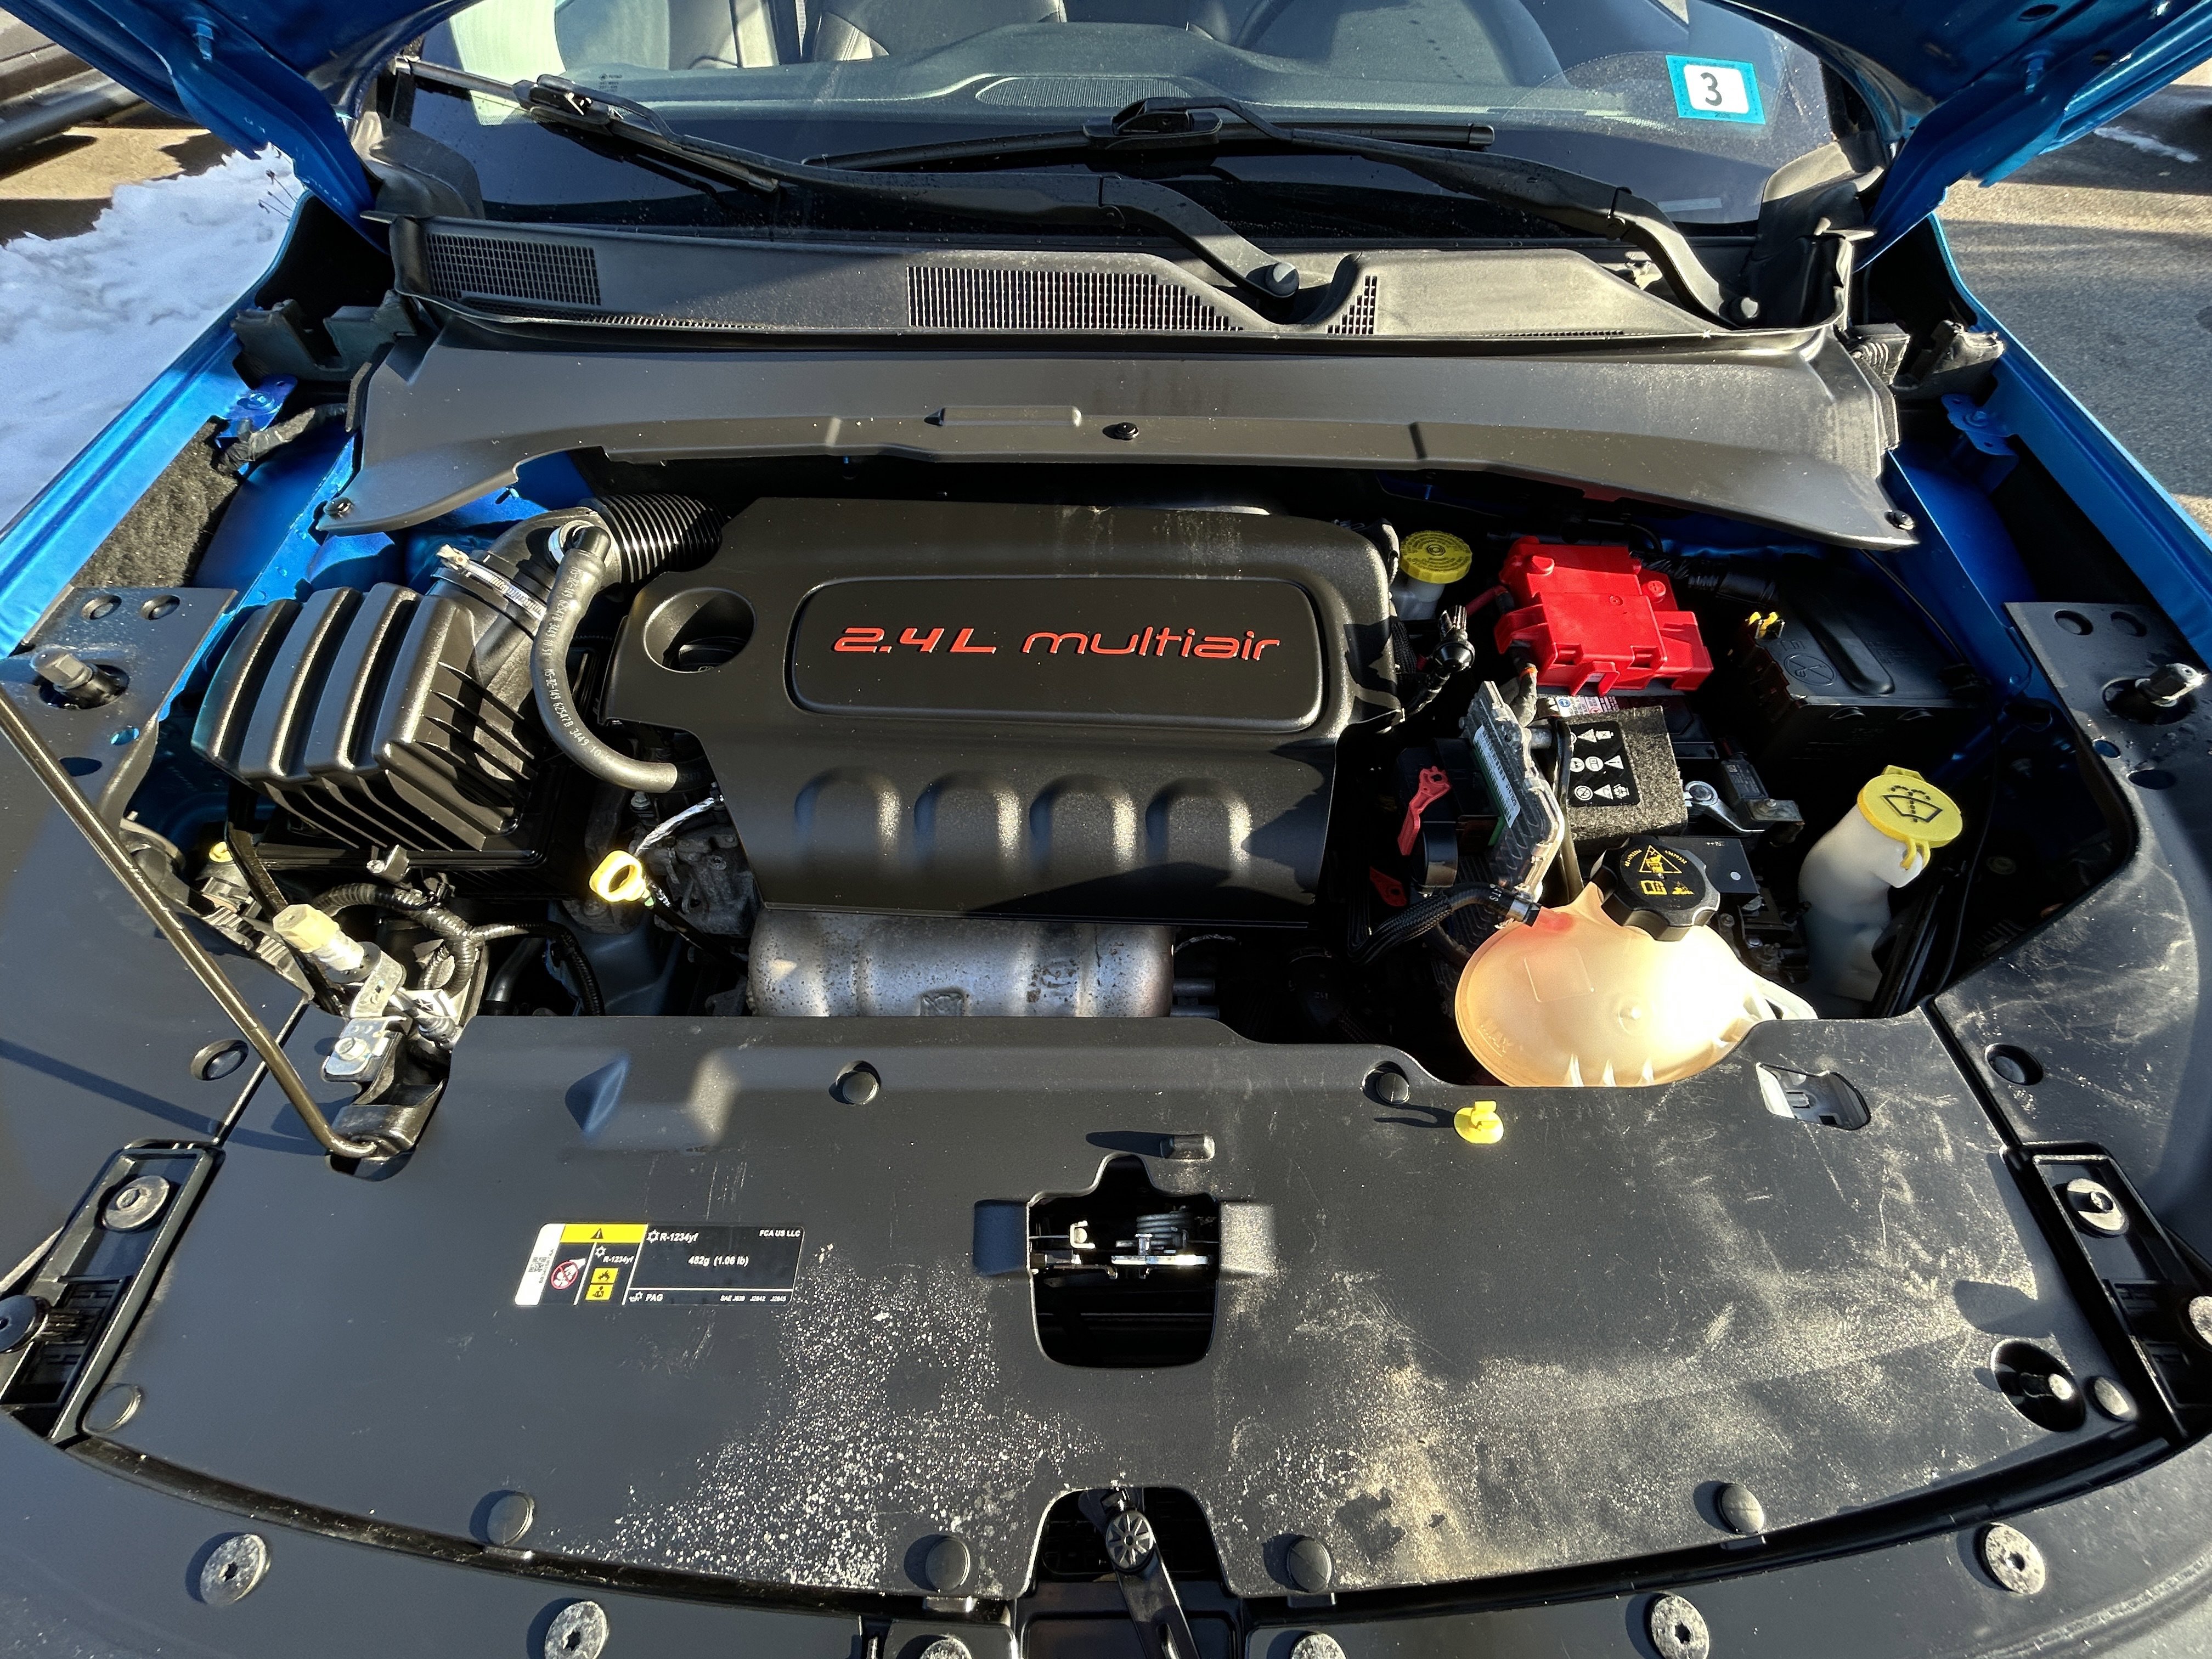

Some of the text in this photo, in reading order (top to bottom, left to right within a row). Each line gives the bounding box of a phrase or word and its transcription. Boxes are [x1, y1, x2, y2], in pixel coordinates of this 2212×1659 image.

[1700, 72, 1723, 106] 3
[1022, 626, 1280, 661] multiair
[569, 727, 590, 746] 3449
[659, 1232, 699, 1243] R-1234yf
[602, 1255, 634, 1265] R-1234yf
[736, 1255, 749, 1267] lb)
[645, 1294, 663, 1302] PAG
